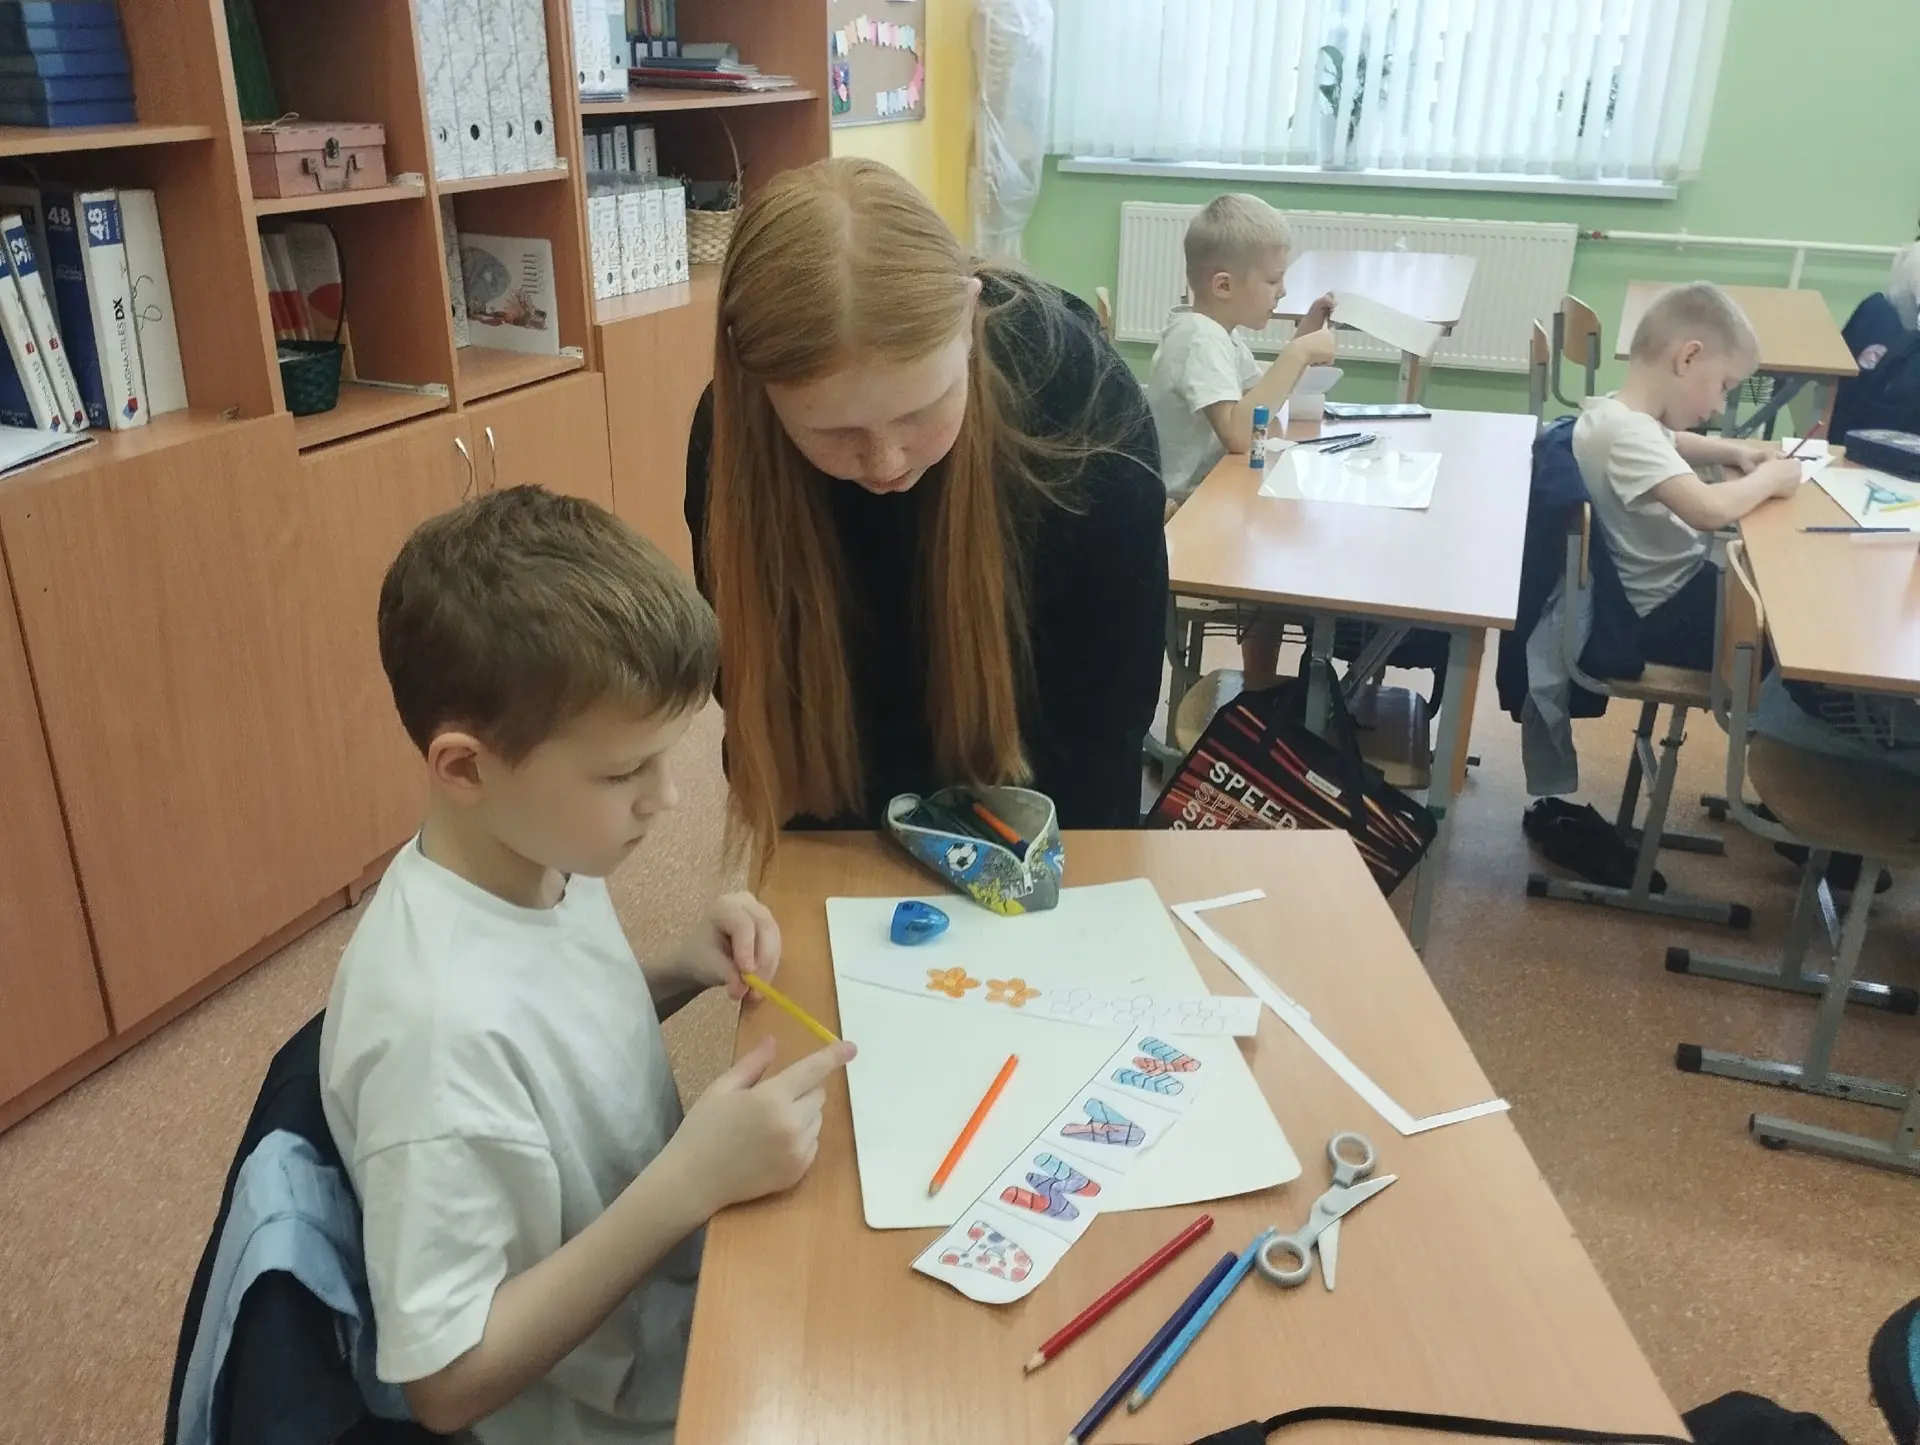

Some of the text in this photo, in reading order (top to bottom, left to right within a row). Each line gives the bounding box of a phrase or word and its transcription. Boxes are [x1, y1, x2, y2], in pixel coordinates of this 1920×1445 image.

[48, 206, 71, 226] 48
[88, 208, 104, 240] 48
[11, 237, 28, 266] 32
[113, 296, 125, 321] DX
[1209, 761, 1298, 830] SPEED
[1182, 799, 1229, 830] SP
